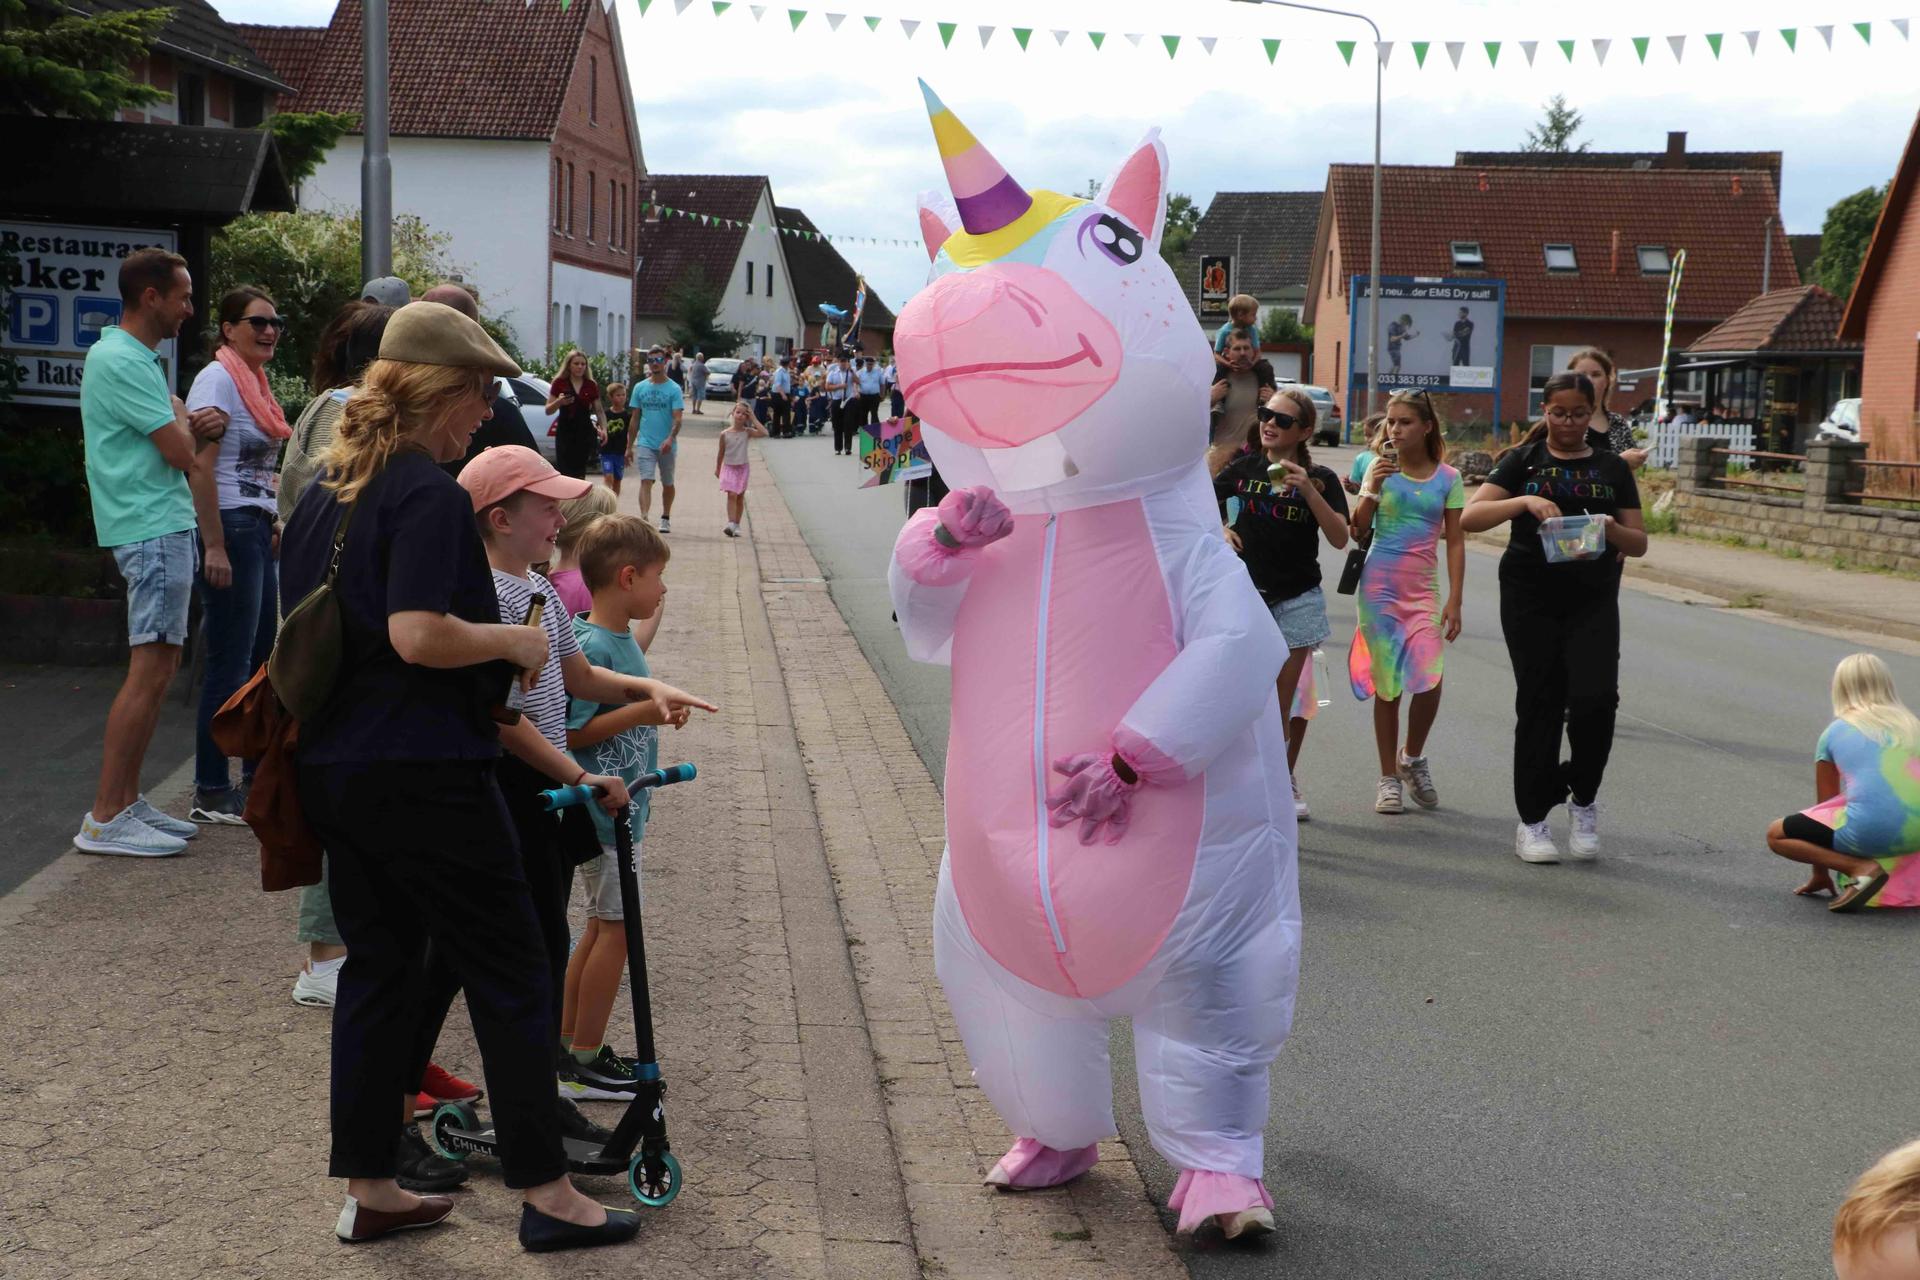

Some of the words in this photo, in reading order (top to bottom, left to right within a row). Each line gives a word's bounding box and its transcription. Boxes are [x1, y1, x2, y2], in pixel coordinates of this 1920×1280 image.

[1364, 286, 1384, 297] jet
[1429, 288, 1451, 297] EMS
[1453, 288, 1469, 299] Dry
[1471, 289, 1491, 298] suit!
[1398, 375, 1415, 384] 383
[1417, 375, 1440, 385] 9512
[873, 431, 913, 450] Rope
[1525, 481, 1616, 501] DANCER
[452, 1137, 493, 1155] CHILLI
